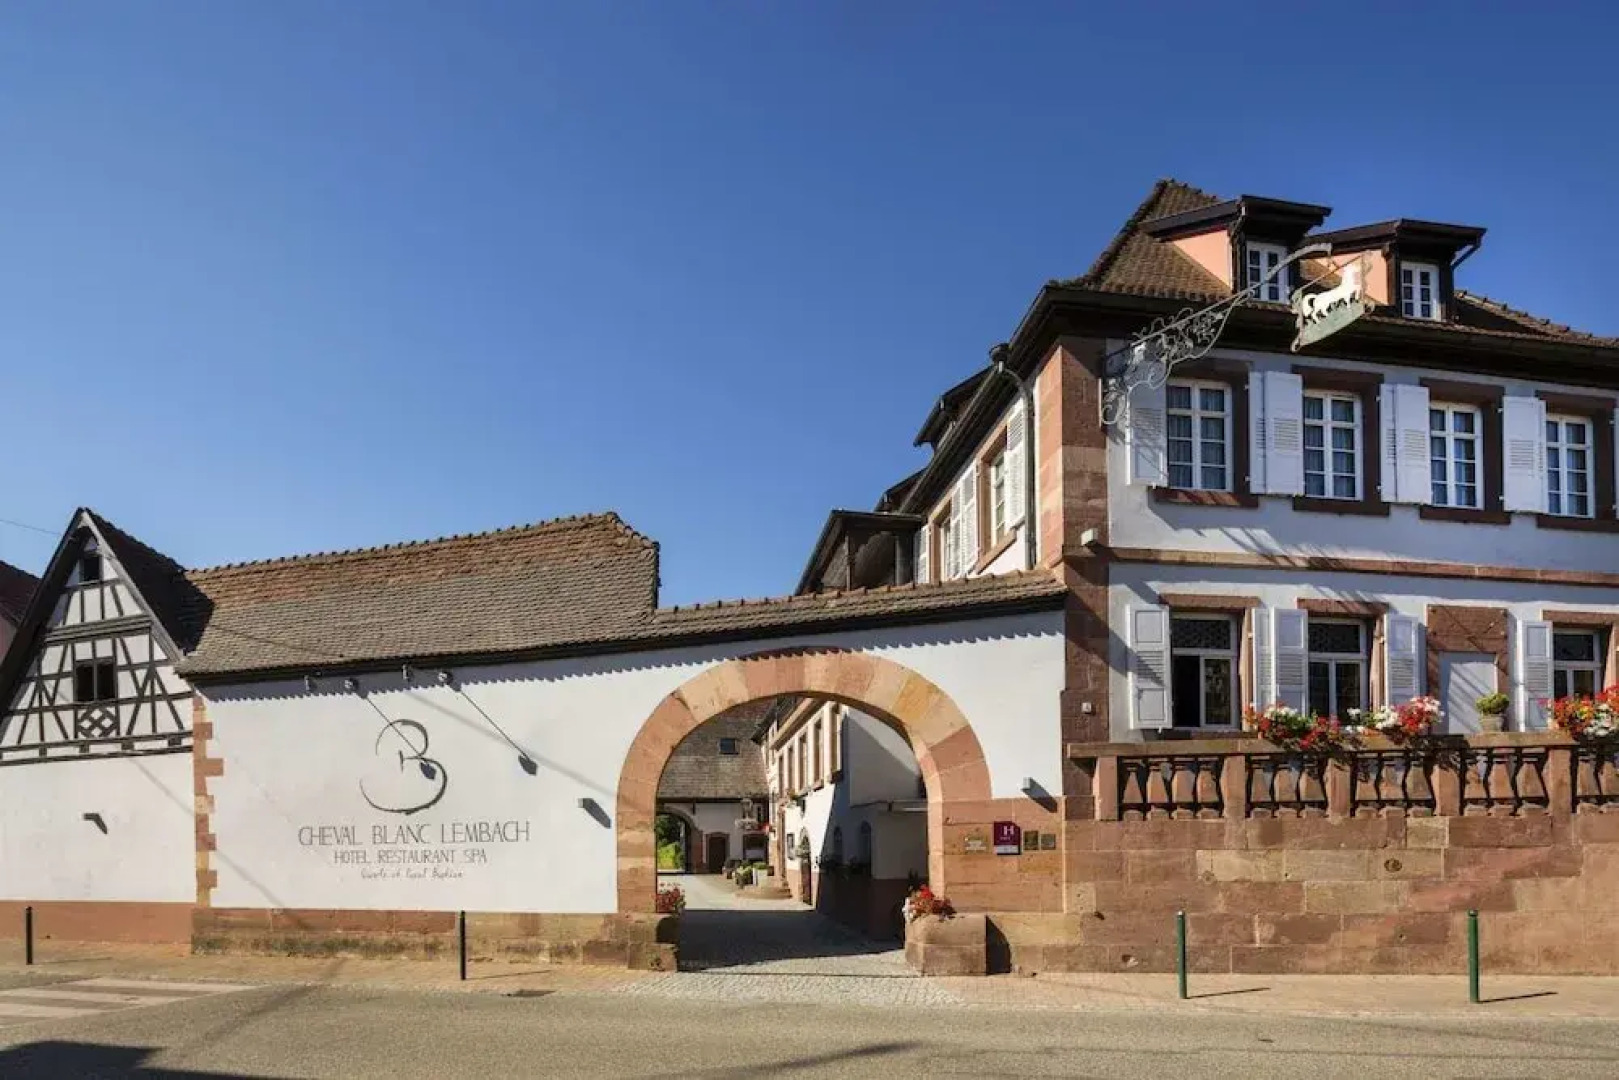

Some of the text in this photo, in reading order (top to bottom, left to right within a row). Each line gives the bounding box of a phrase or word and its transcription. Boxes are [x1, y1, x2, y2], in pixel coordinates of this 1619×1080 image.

[298, 820, 530, 846] CHEVAL BLANC LEMBACH
[1003, 825, 1015, 836] H
[334, 848, 488, 864] HOTEL RESTAURANT SPA
